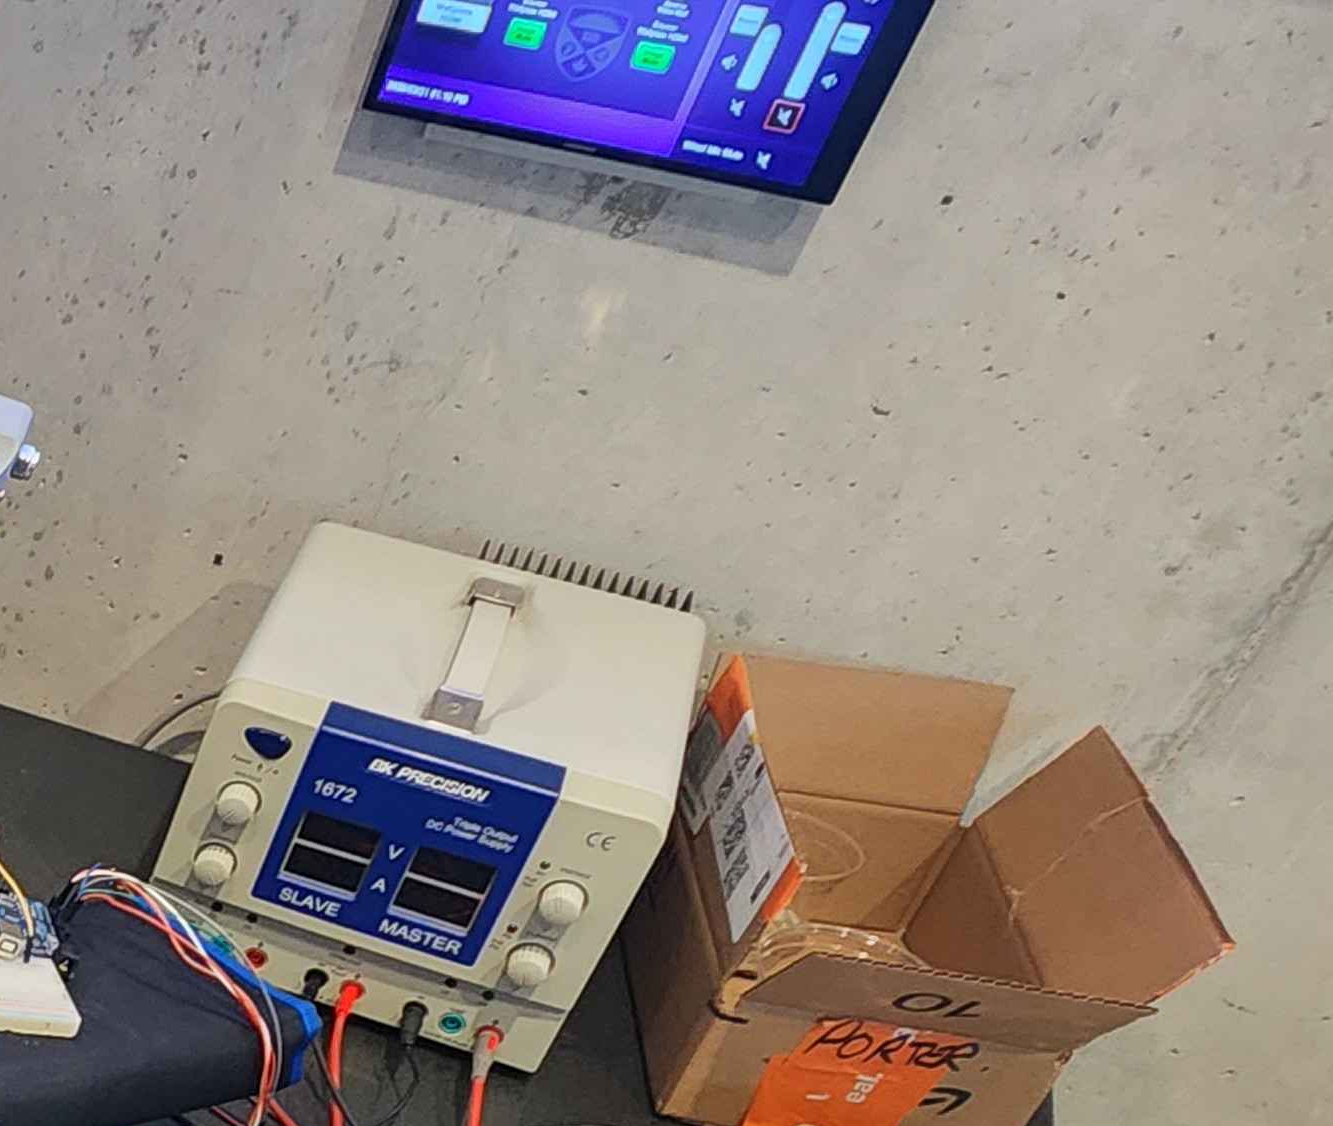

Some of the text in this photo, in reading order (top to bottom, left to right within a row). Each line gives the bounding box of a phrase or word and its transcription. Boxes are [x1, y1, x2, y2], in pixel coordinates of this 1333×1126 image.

[312, 777, 358, 804] 1672
[395, 766, 491, 803] PRECISION
[388, 844, 406, 862] V
[369, 877, 387, 894] A
[277, 887, 343, 918] SLAVE
[378, 918, 464, 956] MASTER
